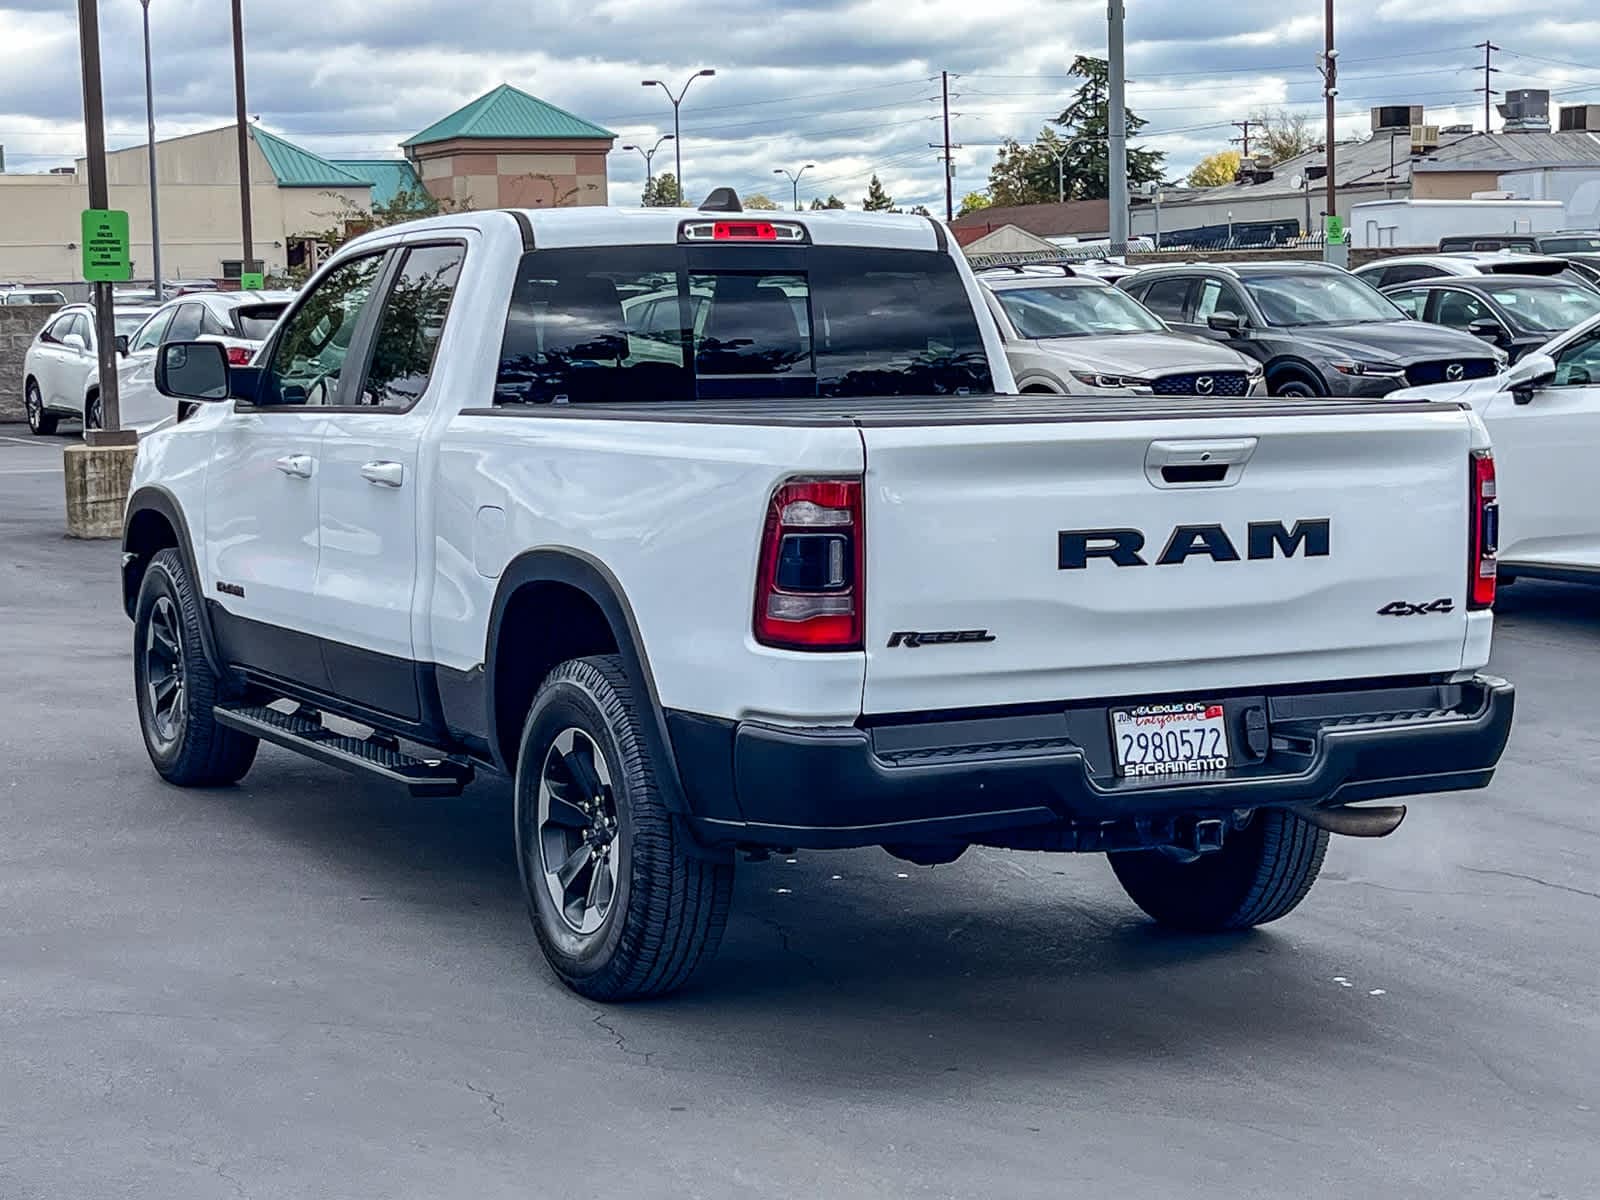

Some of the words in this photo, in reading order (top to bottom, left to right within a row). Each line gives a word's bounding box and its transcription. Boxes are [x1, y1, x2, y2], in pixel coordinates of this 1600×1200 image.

[1058, 518, 1330, 570] RAM
[1146, 703, 1184, 714] LEXUS
[1185, 702, 1202, 712] OF
[1124, 757, 1228, 776] SACRAMENTO
